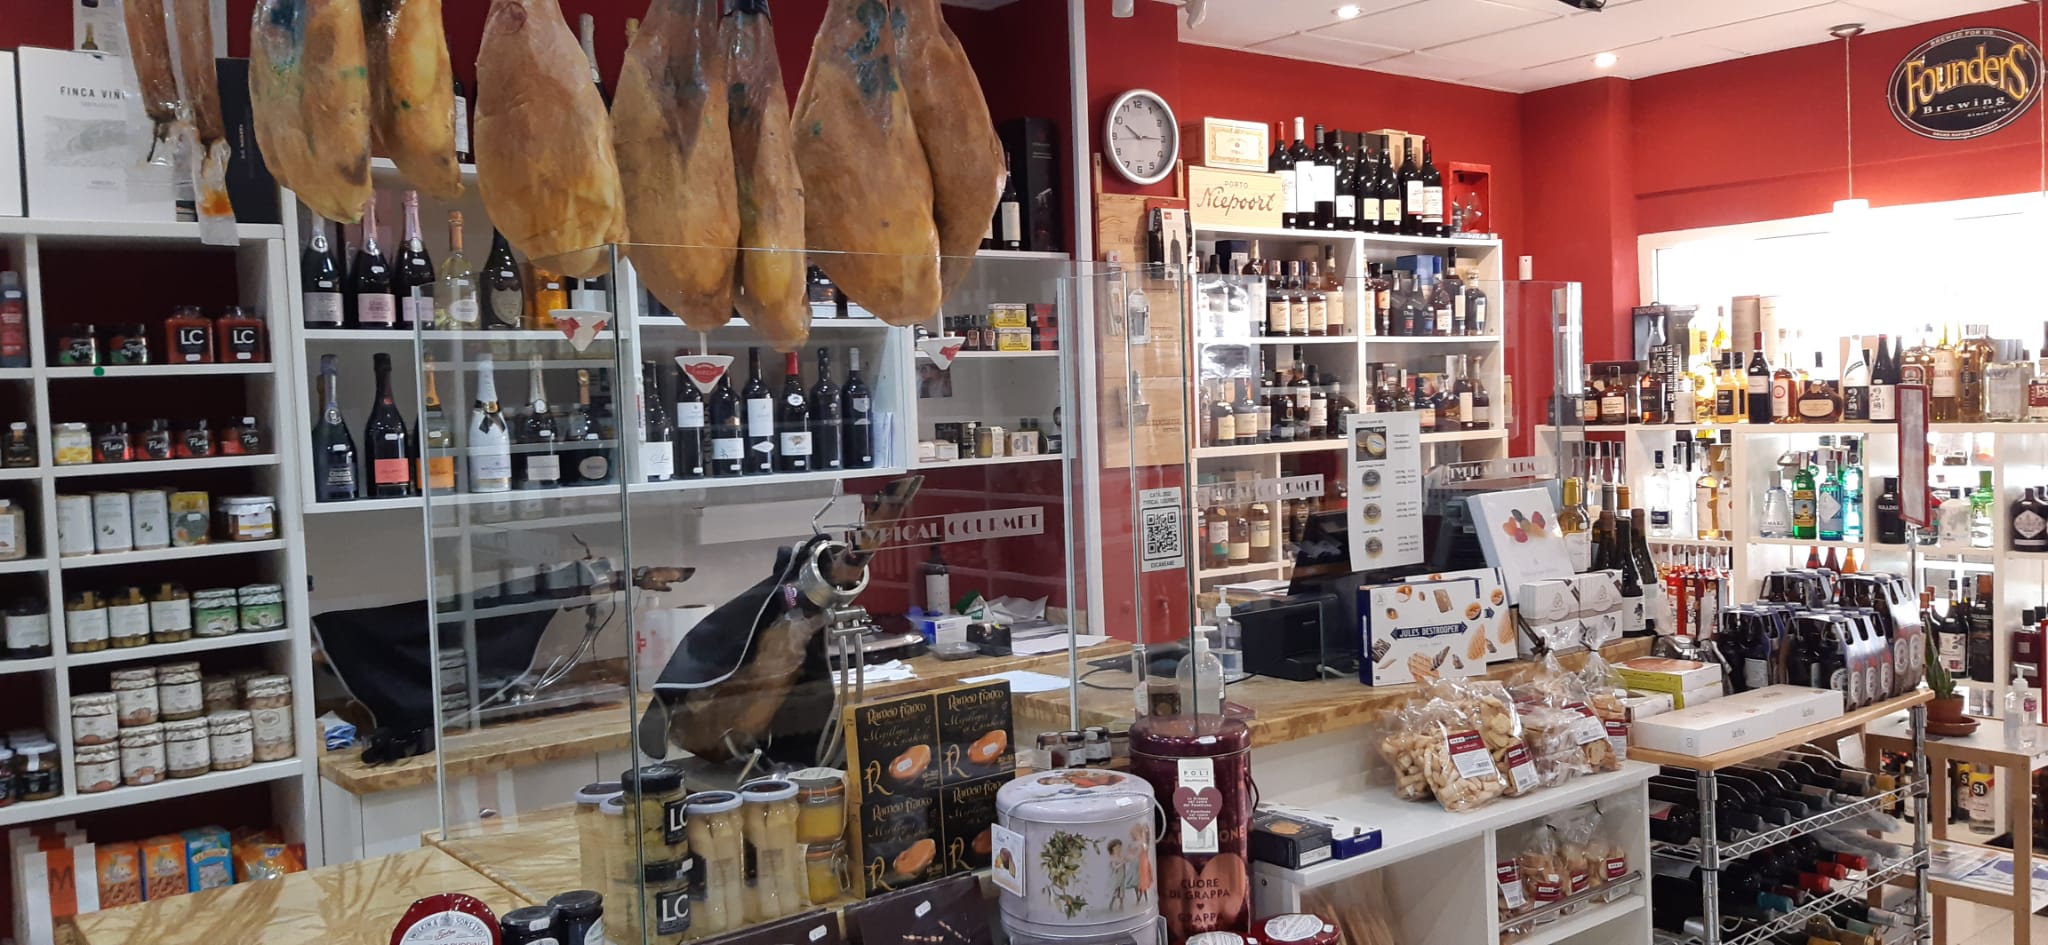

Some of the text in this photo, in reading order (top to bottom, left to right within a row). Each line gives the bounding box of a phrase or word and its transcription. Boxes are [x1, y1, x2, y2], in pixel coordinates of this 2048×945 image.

[60, 86, 96, 98] FINCA
[1122, 104, 1130, 113] 11
[1132, 101, 1143, 109] 12
[1923, 96, 2006, 115] Brewing
[1224, 180, 1249, 190] PORTO
[1196, 185, 1277, 217] Niepoort
[180, 329, 204, 345] LC
[233, 329, 255, 345] LC
[853, 513, 1040, 546] TYPICAL GOURMET
[1399, 624, 1460, 638] JULES DESTROOPER
[1972, 786, 1985, 794] 51
[670, 803, 689, 833] LC
[1180, 879, 1220, 890] CUORE
[1187, 888, 1231, 900] GRAPPA
[661, 894, 689, 923] LC
